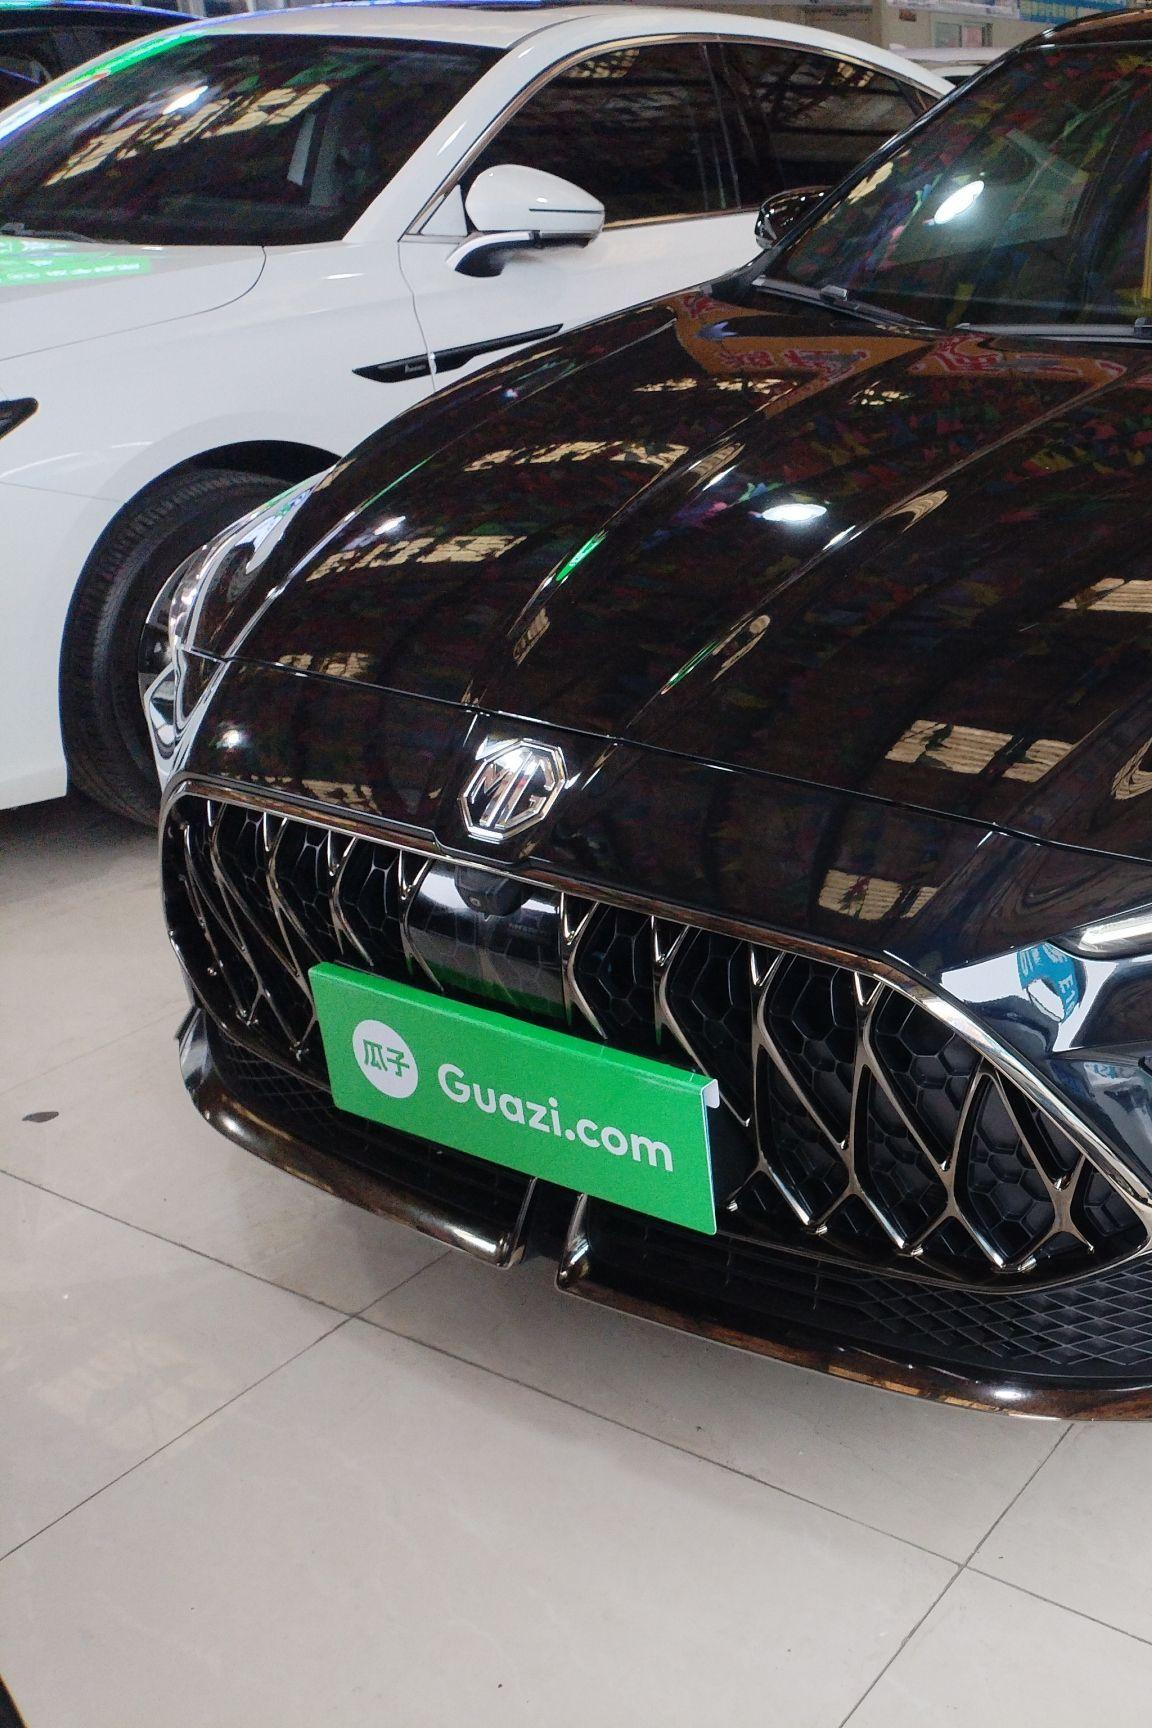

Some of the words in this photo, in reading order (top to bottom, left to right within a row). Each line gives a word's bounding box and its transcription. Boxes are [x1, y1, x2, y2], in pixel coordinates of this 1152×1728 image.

[470, 751, 556, 829] MG
[362, 1038, 410, 1078] 瓜子
[437, 1063, 674, 1173] Guazi.com
